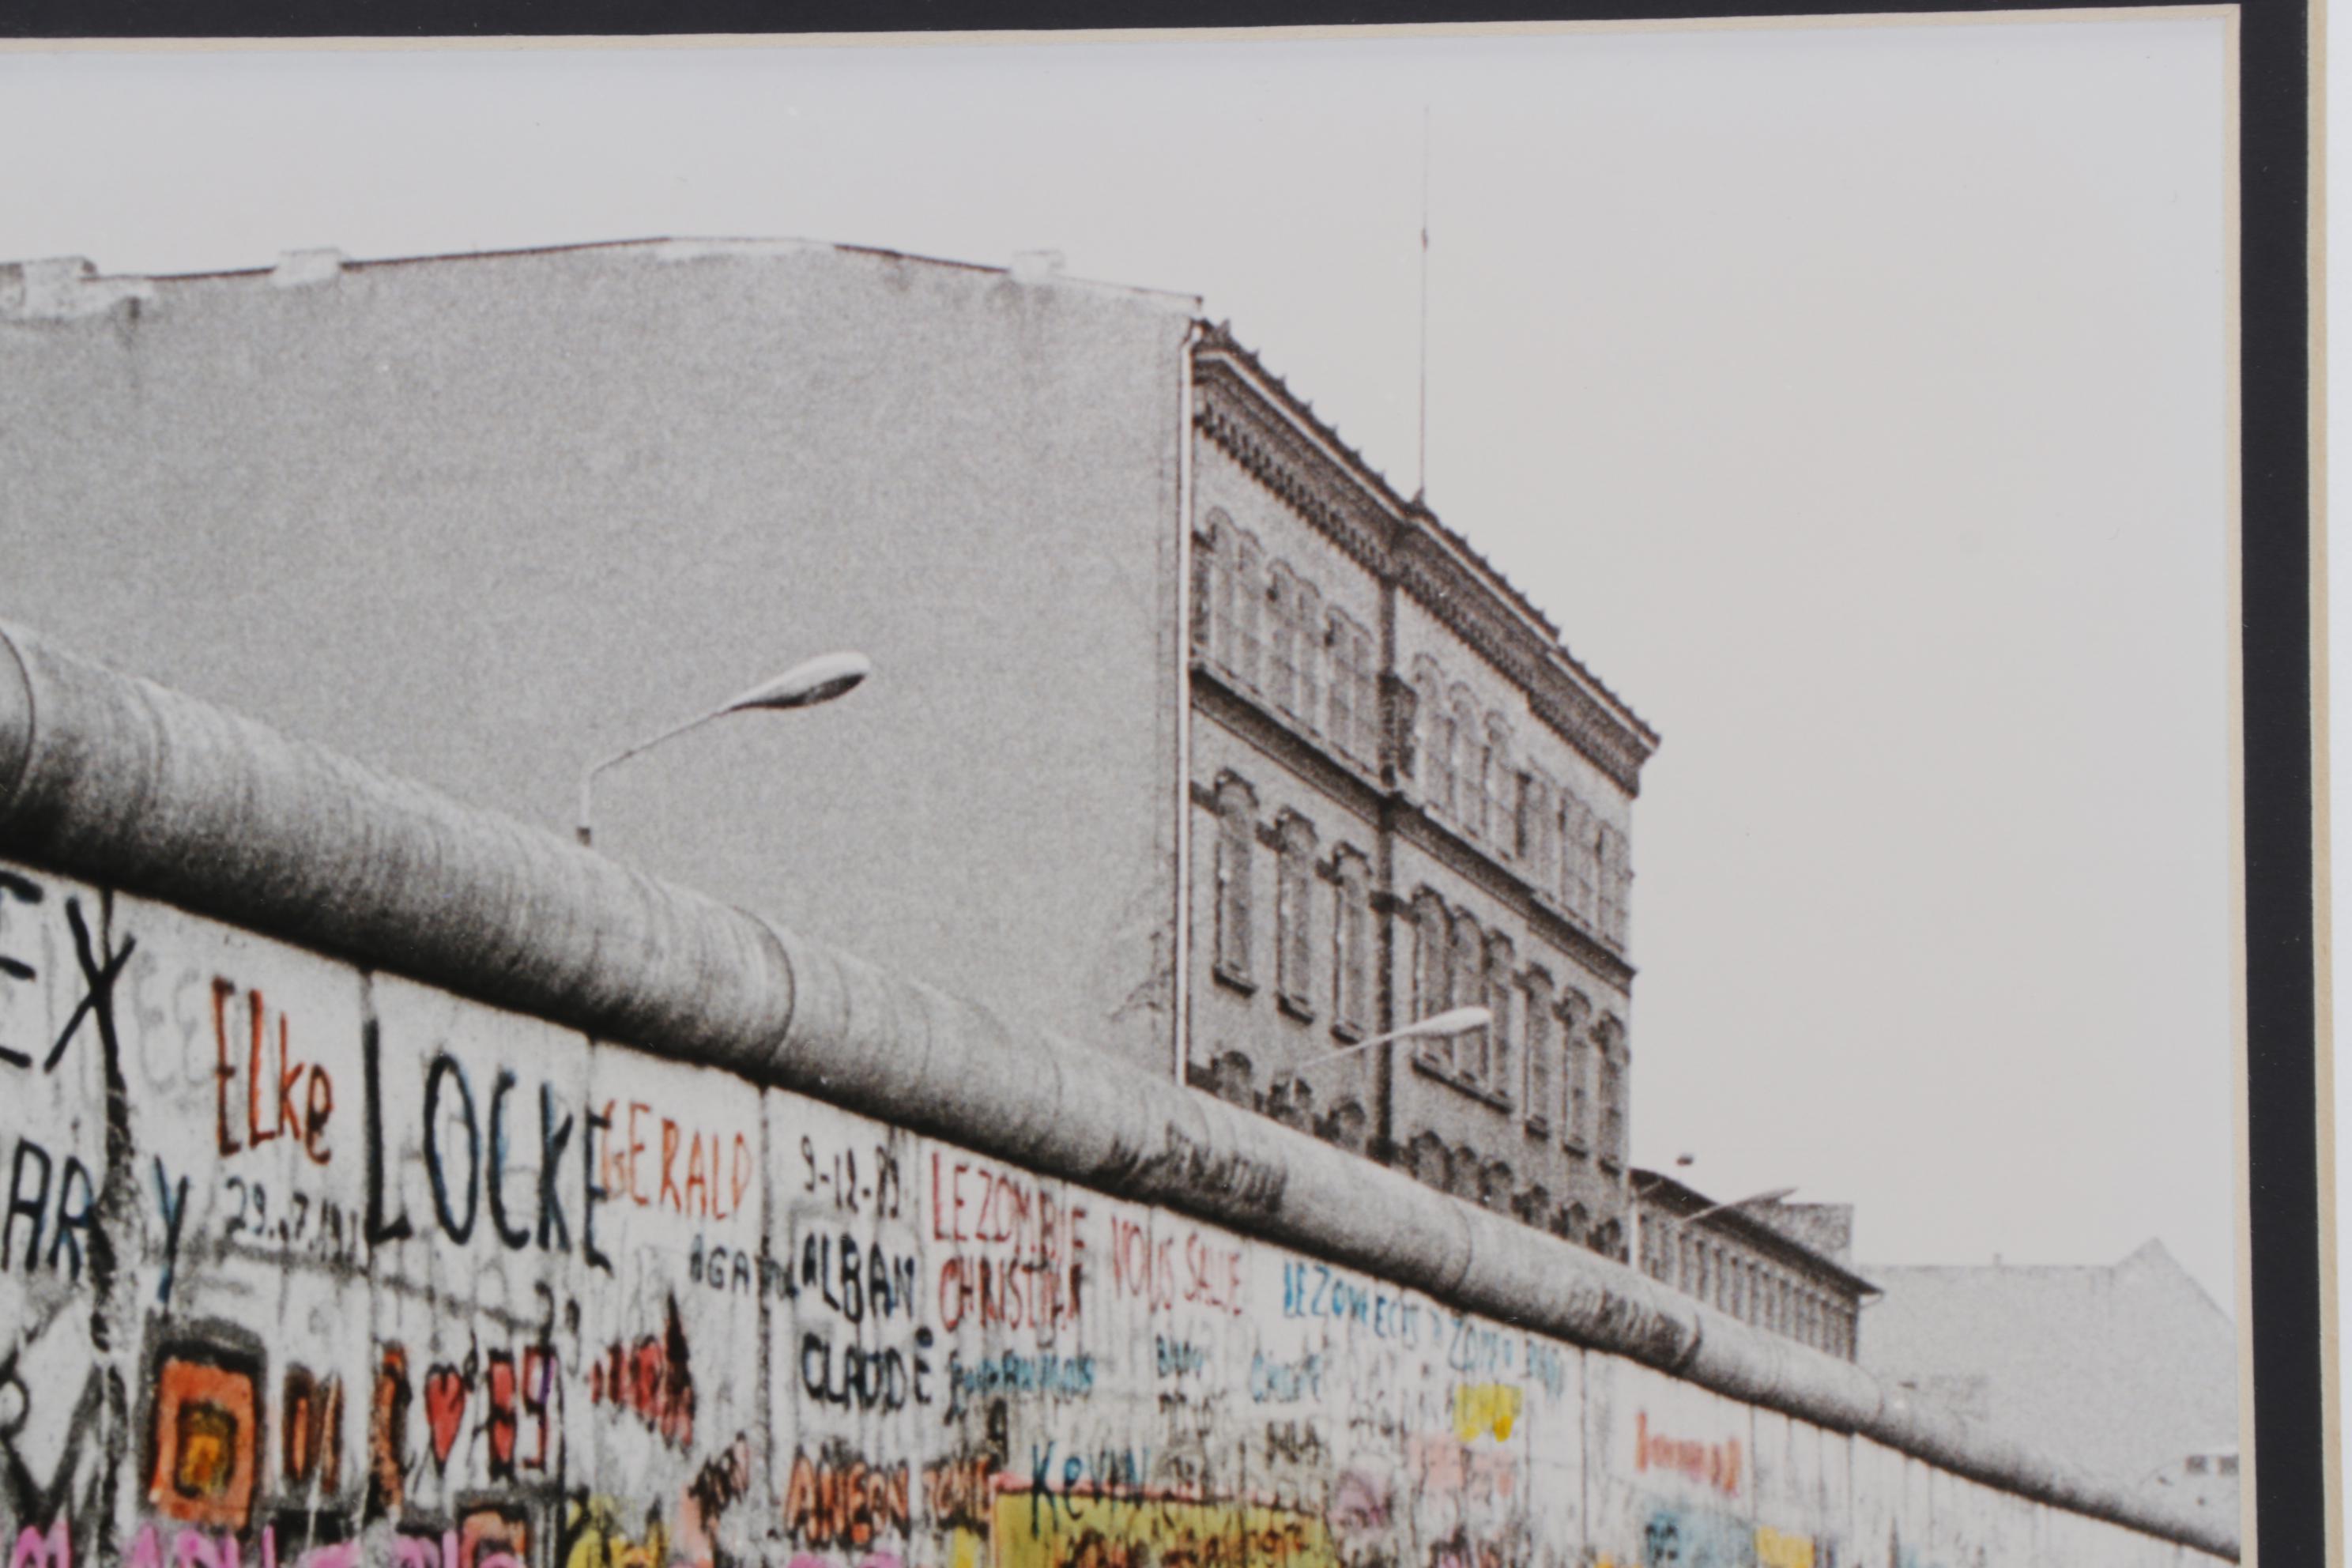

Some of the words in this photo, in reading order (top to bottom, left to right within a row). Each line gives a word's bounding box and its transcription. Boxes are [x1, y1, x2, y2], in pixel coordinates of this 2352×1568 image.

[361, 1018, 614, 1279] LOCKE
[602, 1097, 752, 1221] GERALD
[803, 1231, 914, 1323] ALBAN
